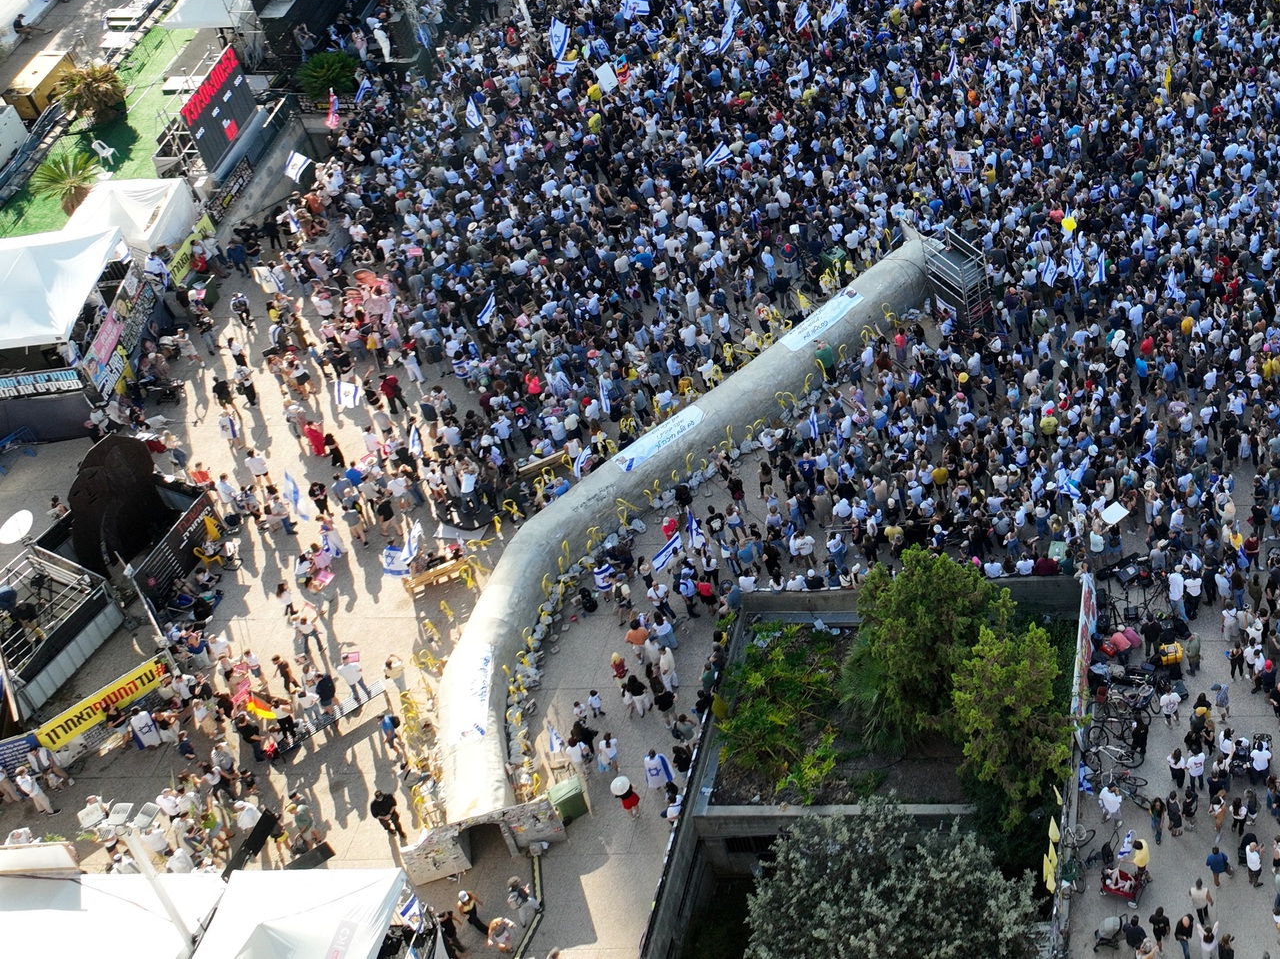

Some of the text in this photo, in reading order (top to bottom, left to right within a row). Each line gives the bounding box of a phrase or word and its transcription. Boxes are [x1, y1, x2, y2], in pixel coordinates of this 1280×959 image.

[17, 374, 35, 386] את
[36, 369, 79, 383] מחזירים
[17, 384, 36, 395] את
[35, 379, 83, 393] מפסיקים
[176, 498, 207, 534] השבת
[182, 506, 211, 540] השחורה
